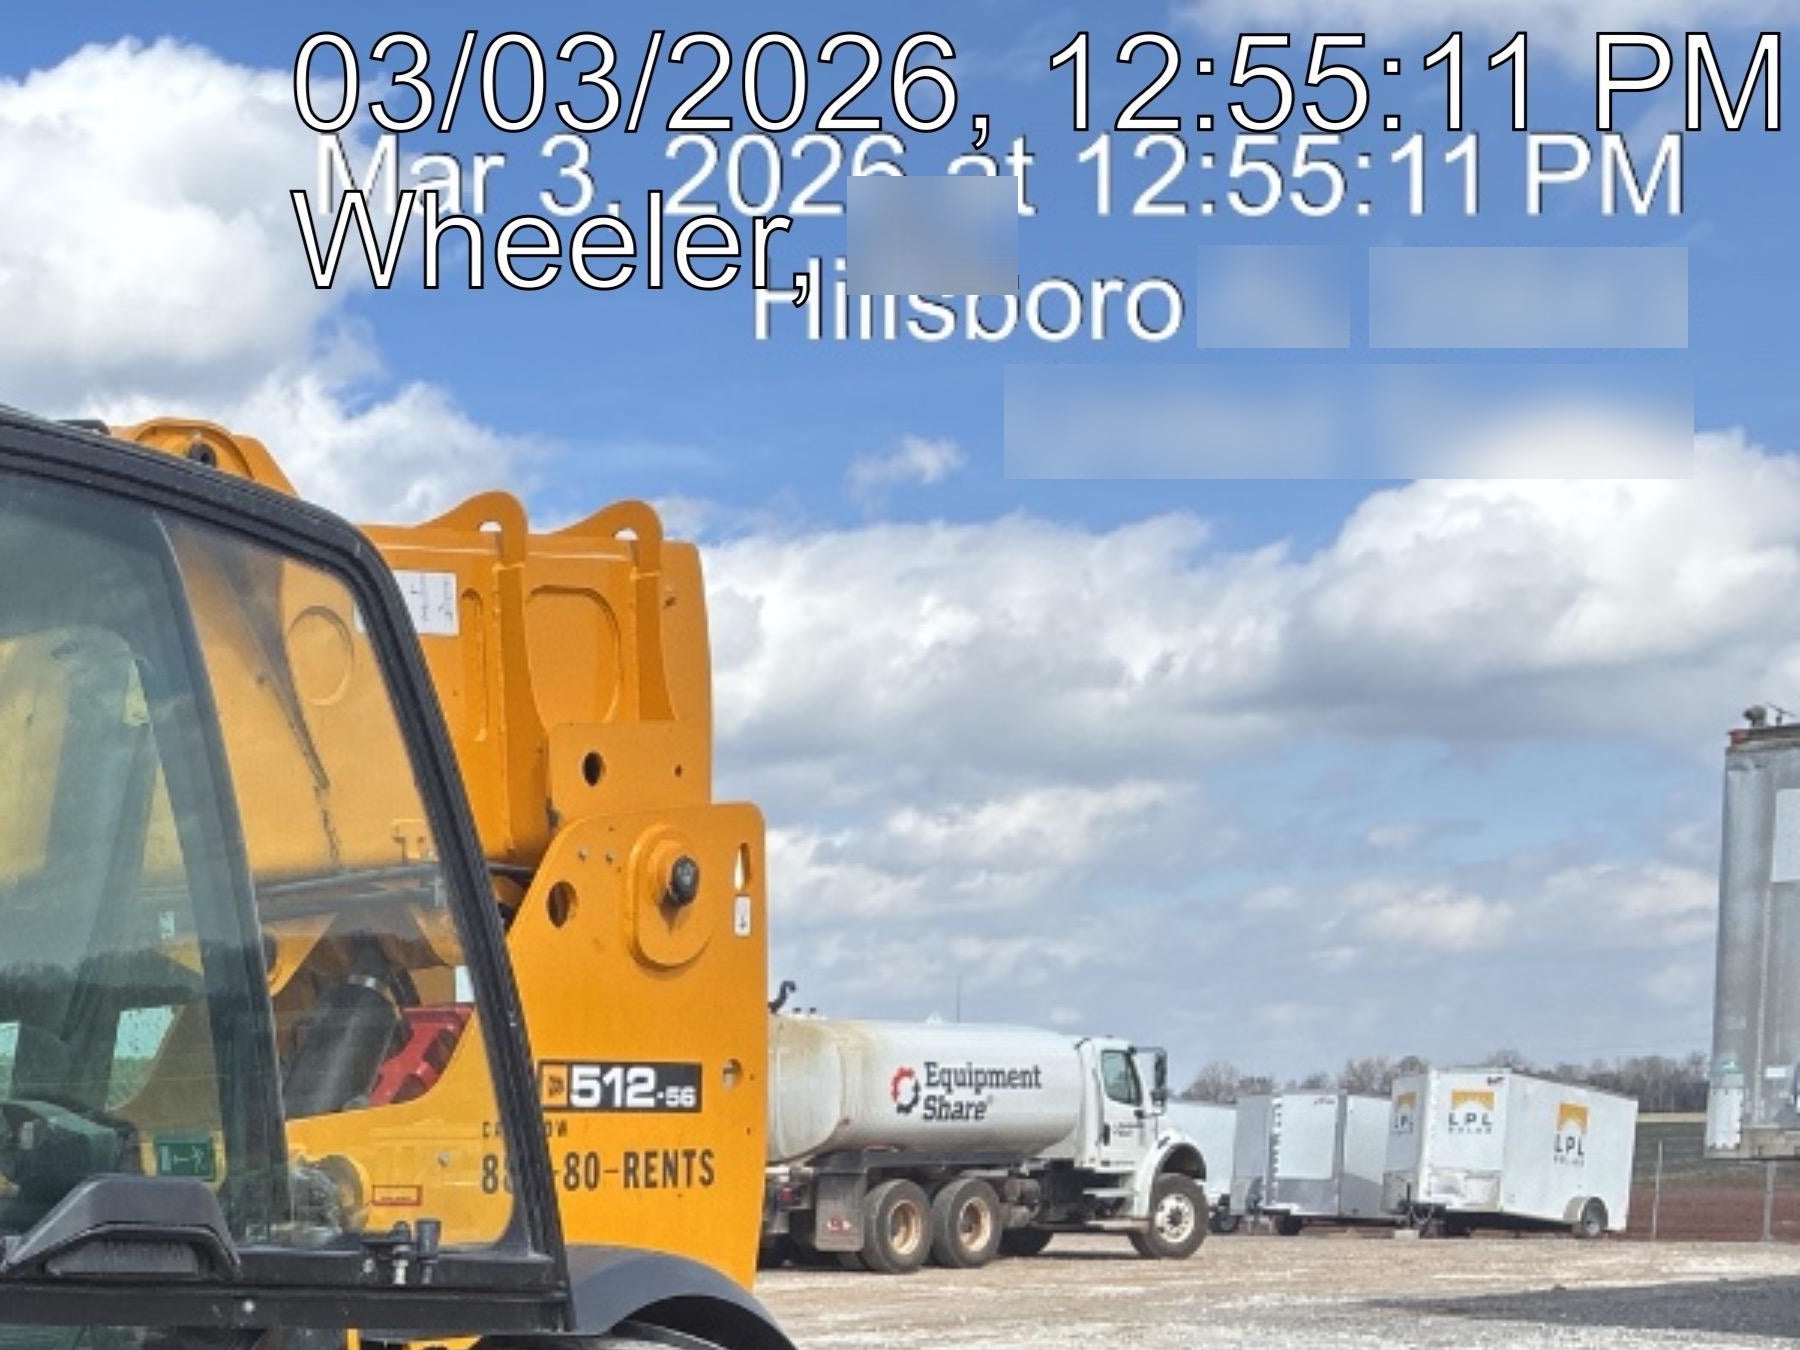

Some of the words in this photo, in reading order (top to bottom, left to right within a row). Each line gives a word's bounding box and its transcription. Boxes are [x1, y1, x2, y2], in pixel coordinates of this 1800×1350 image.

[923, 1062, 1041, 1094] Equipment
[922, 1095, 988, 1121] Share
[1449, 1112, 1492, 1126] LPL
